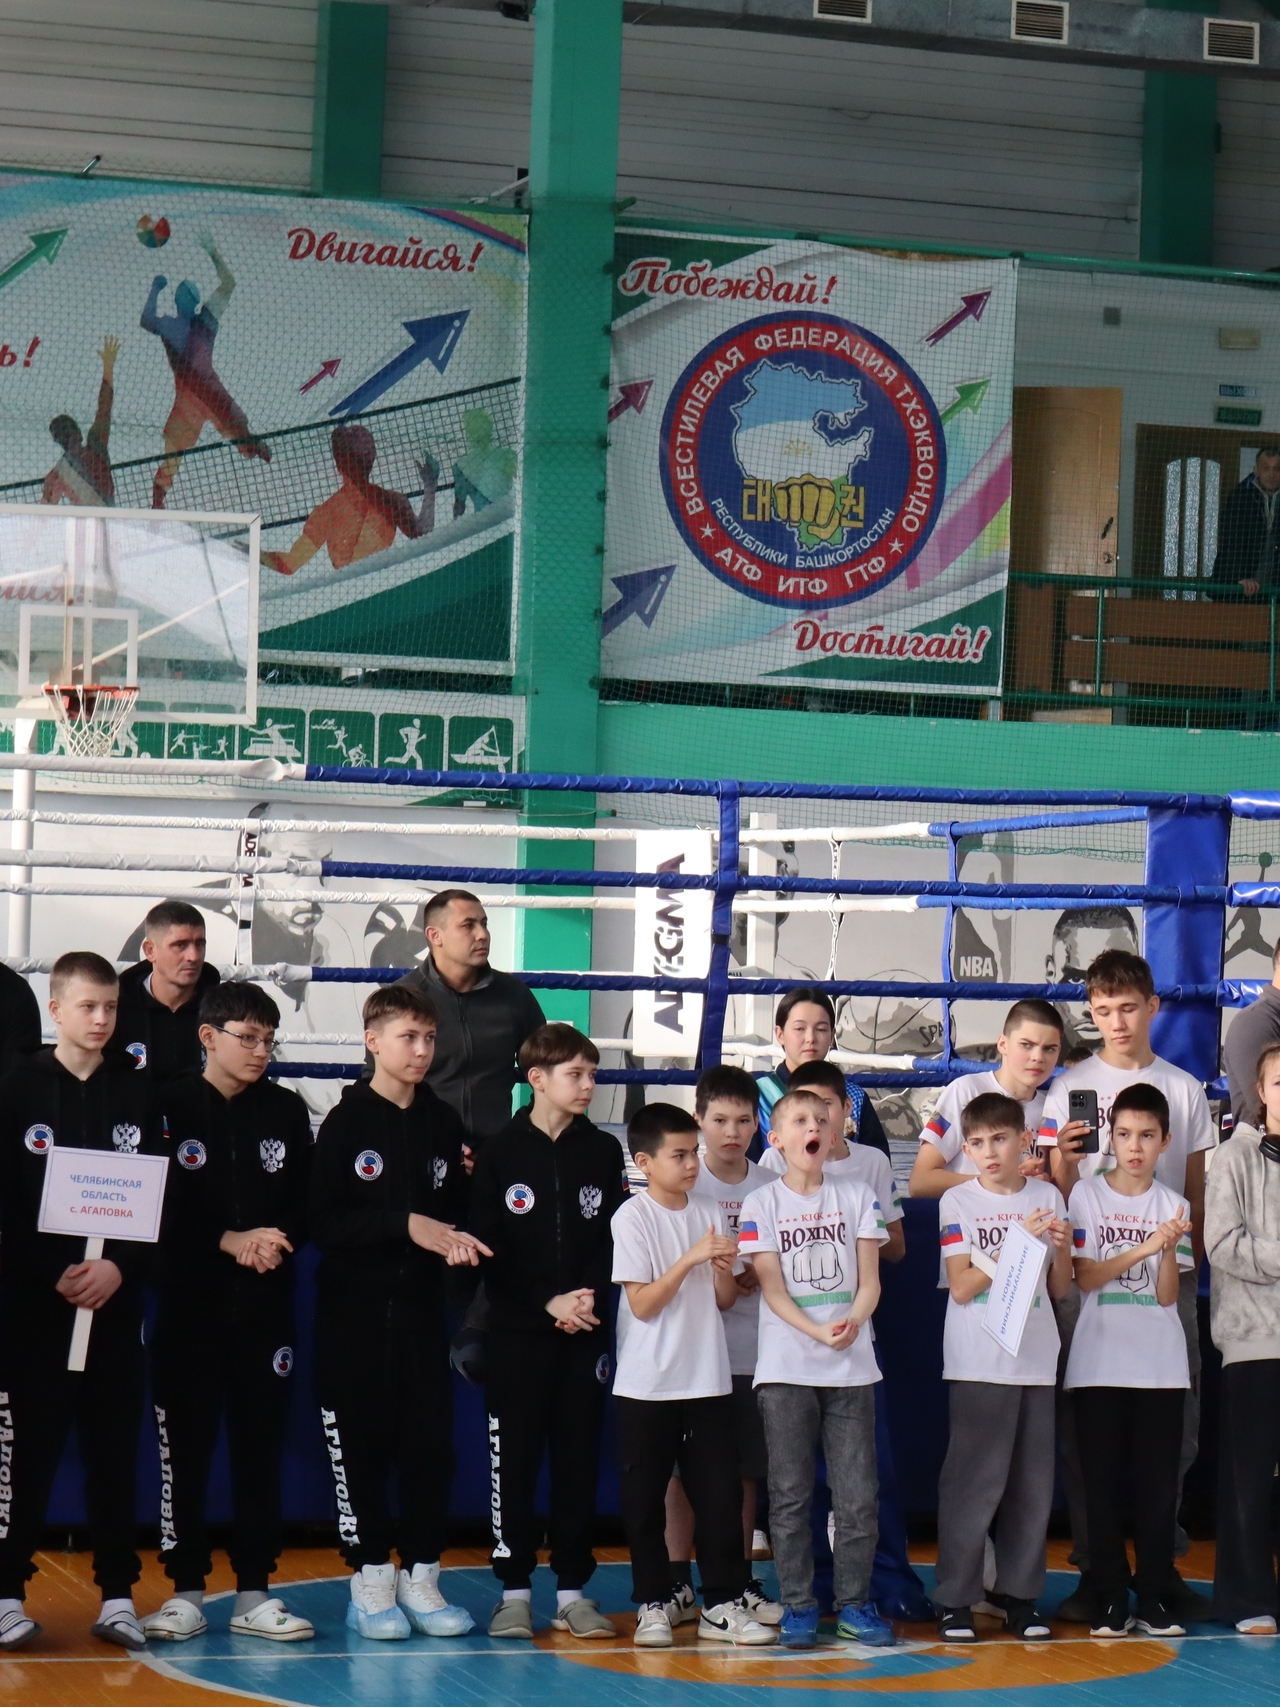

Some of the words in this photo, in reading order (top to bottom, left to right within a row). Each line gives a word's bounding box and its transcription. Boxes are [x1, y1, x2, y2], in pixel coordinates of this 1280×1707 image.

[288, 228, 485, 272] Двигайся!
[622, 261, 837, 304] Побеждай!
[676, 347, 745, 515] ВСЕСТИЛЕВАЯ
[754, 326, 897, 385] ФЕДЕРАЦИЯ
[896, 384, 935, 531] ТХЭКВОНДО
[711, 498, 788, 565] РЕСПУБЛИКИ
[795, 508, 895, 568] БАШКОРТОСТАН
[715, 547, 762, 581] АТФ
[778, 576, 828, 595] ИТФ
[844, 555, 887, 588] ГТФ
[794, 620, 987, 659] Достигай!
[960, 956, 994, 977] NBA
[70, 1174, 142, 1189] ЧЕЛЯБИНСКАЯ
[81, 1190, 127, 1202] ОБЛАСТЬ
[70, 1206, 77, 1214] с.
[80, 1205, 133, 1218] АГАПОВКА
[1113, 1213, 1140, 1224] KICK
[1002, 1265, 1014, 1302] РАЙОН
[154, 1404, 178, 1551] АГАПОВКА
